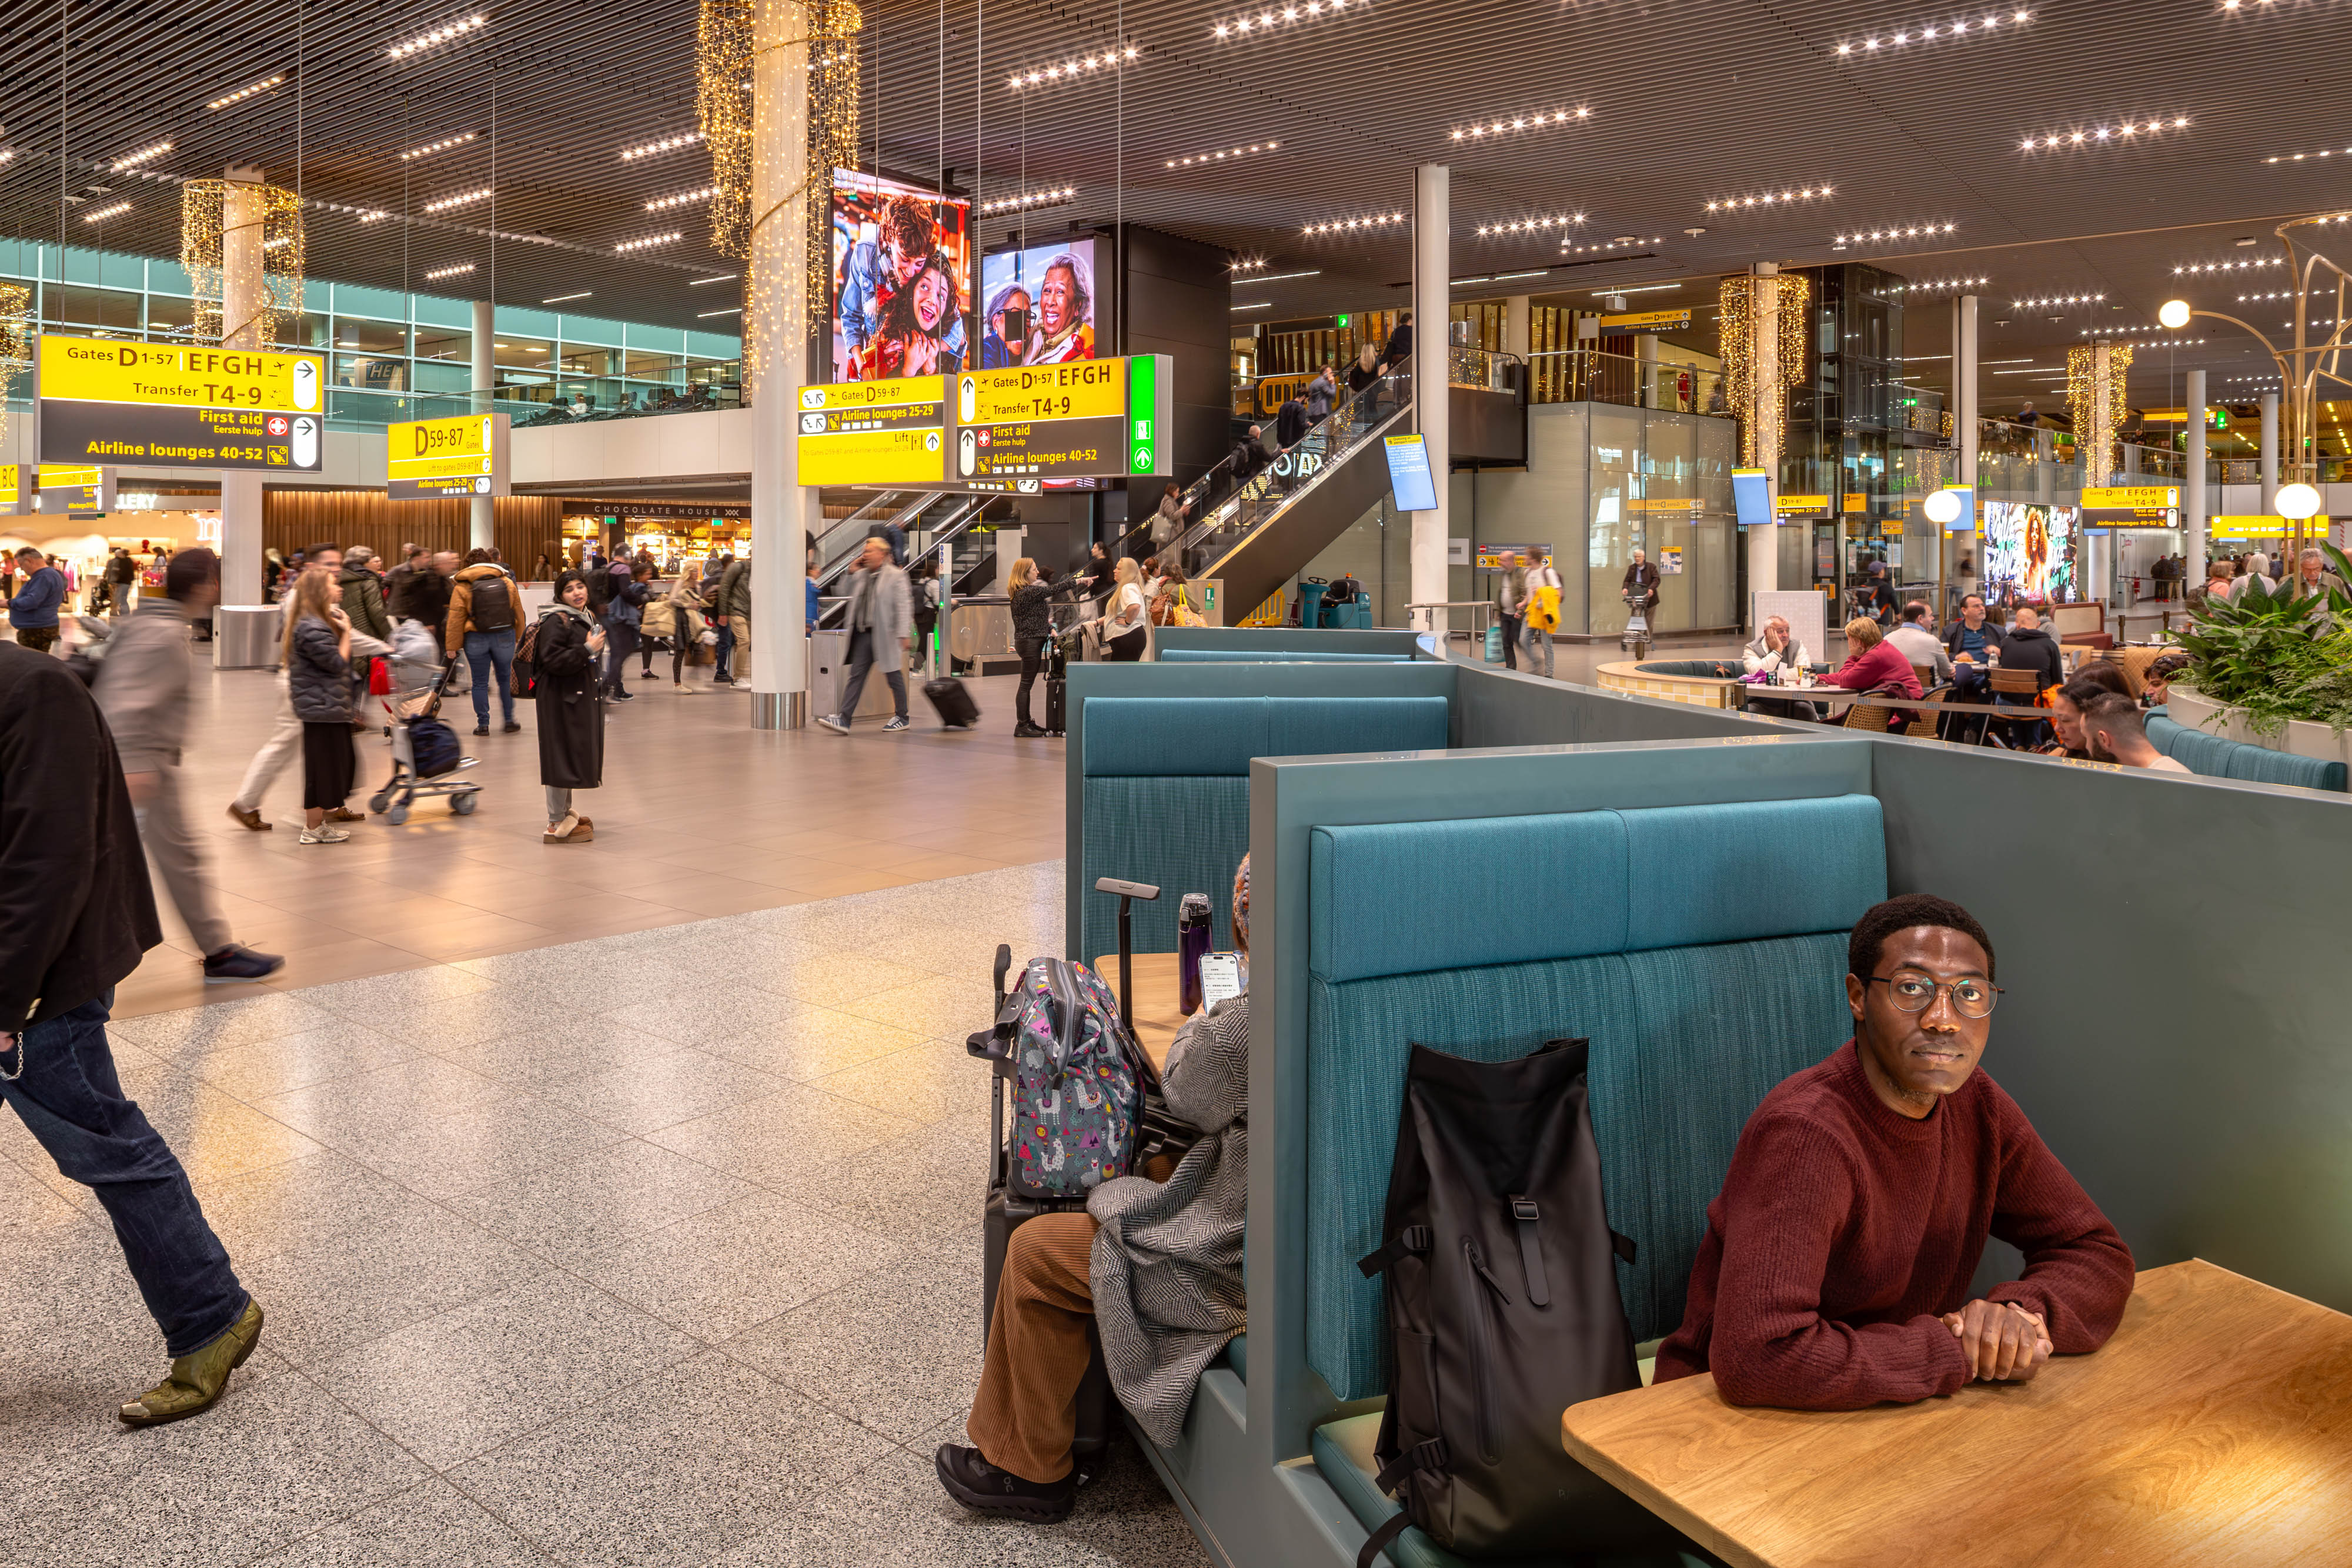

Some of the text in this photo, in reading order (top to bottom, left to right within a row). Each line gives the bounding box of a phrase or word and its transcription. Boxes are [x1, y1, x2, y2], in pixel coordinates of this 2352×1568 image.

[68, 347, 113, 360] Gates
[994, 376, 1018, 388] Gates
[133, 383, 199, 397] Transfer
[841, 392, 864, 400] Gates
[841, 404, 934, 421] Airline lounges 25-29
[993, 402, 1030, 415] Transfer
[200, 410, 263, 425] First aid
[214, 426, 263, 437] Eerste hulp
[993, 424, 1030, 437] First aid
[895, 433, 908, 443] Lift
[993, 438, 1026, 447] Eerste hulp
[86, 441, 263, 460] Airline lounges 40-52
[992, 449, 1097, 465] Airline lounges 40-52
[443, 463, 456, 473] gates
[417, 478, 467, 489] Airline lounges 25-29
[594, 506, 670, 514] CHOCOLATE
